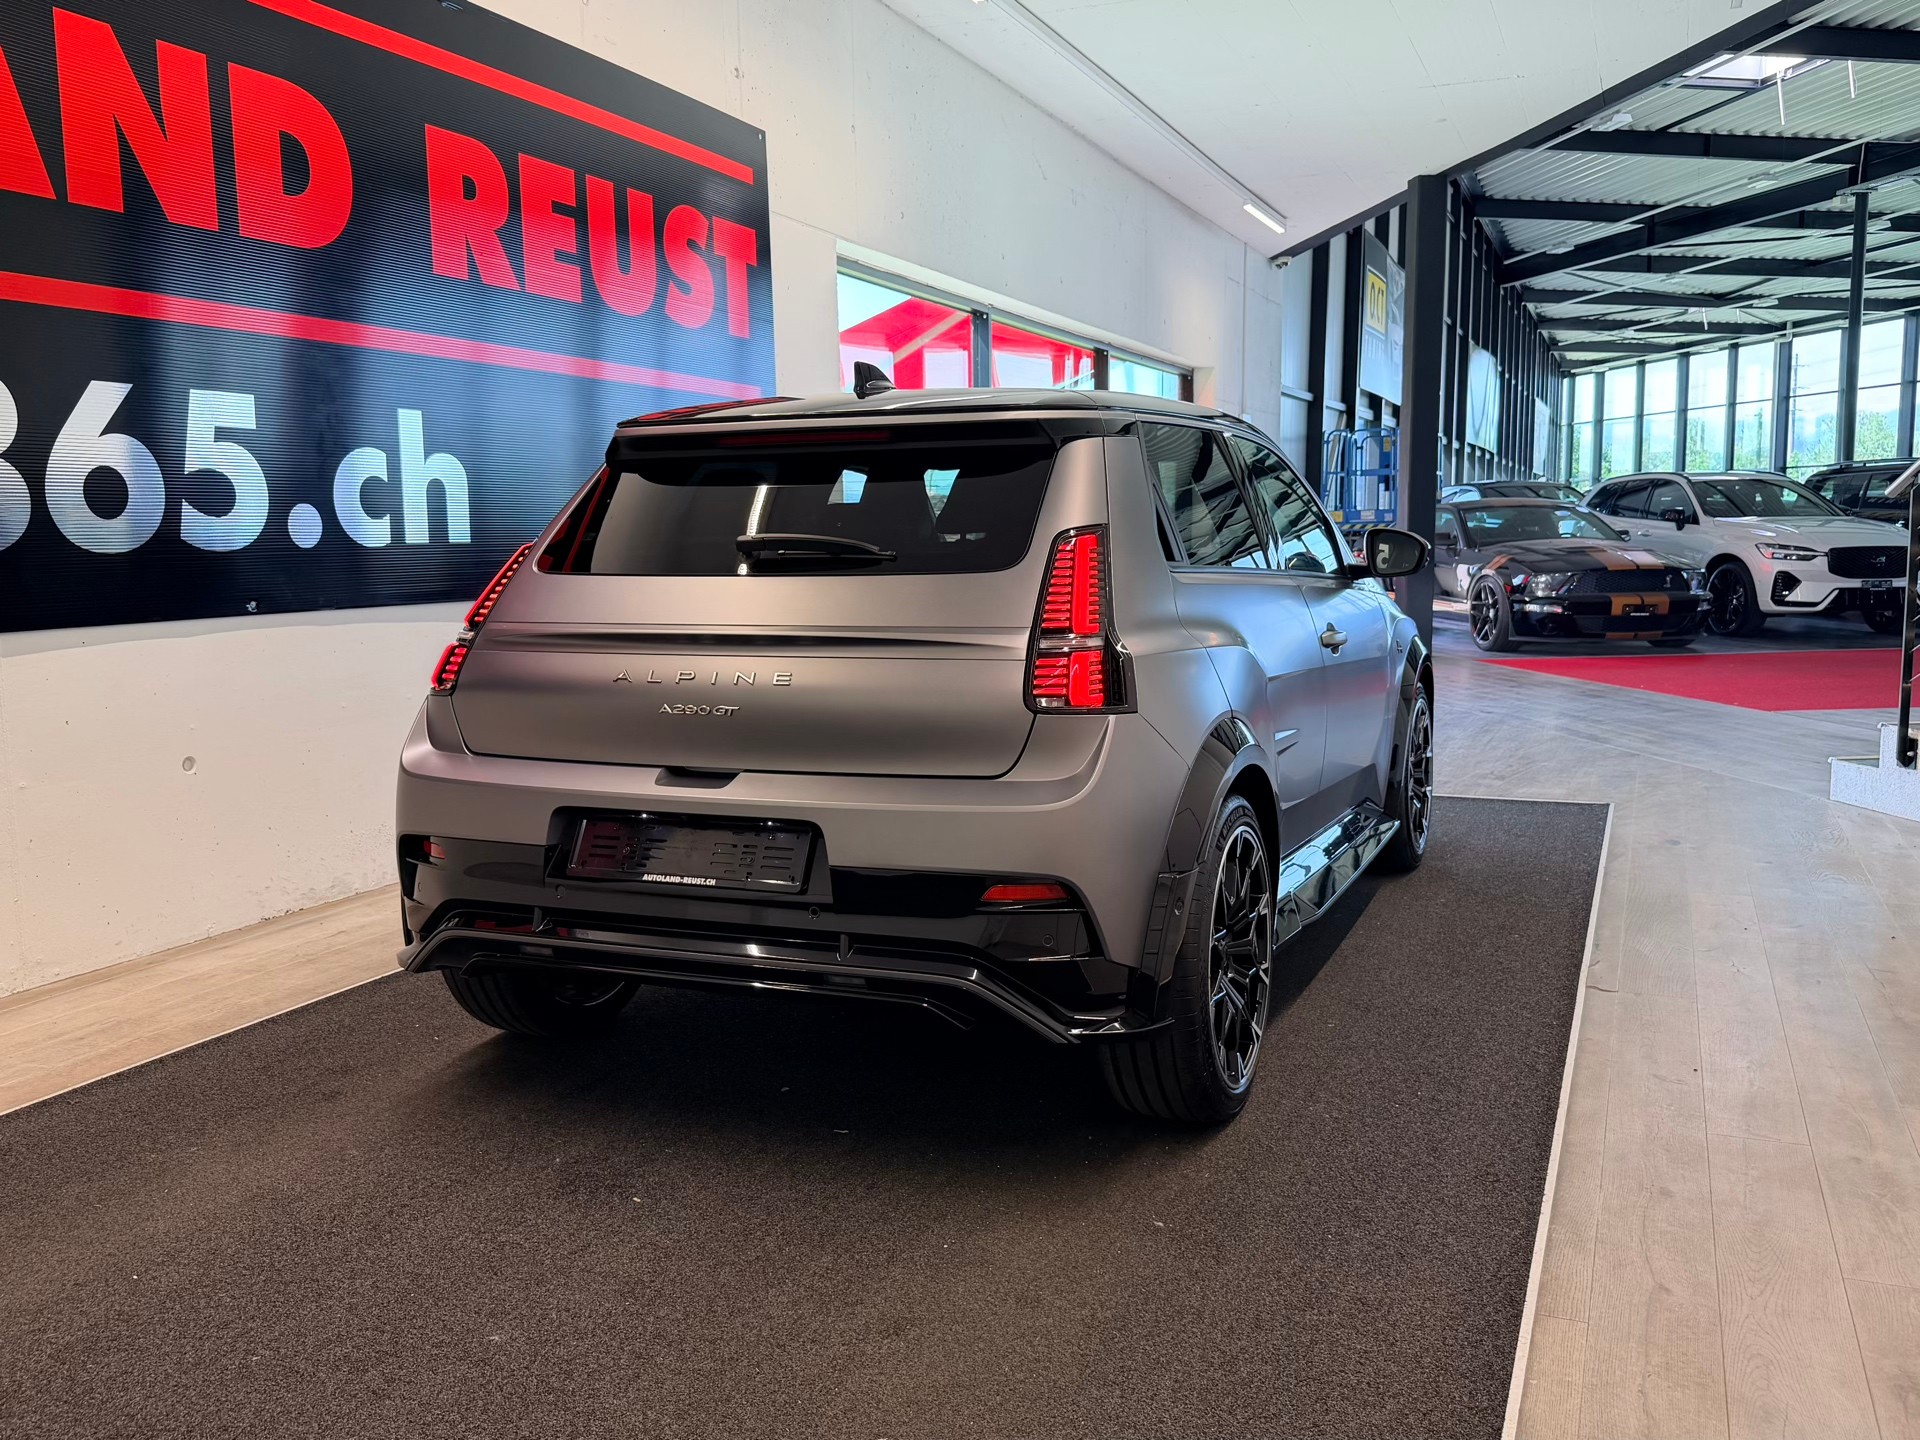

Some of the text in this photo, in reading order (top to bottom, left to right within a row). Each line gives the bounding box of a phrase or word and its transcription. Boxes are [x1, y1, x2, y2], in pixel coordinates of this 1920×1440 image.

[425, 123, 757, 340] REUST
[613, 669, 793, 686] ALPINE
[659, 703, 740, 716] A290 GT
[642, 873, 717, 886] AUTOLAND-REUST.CH
